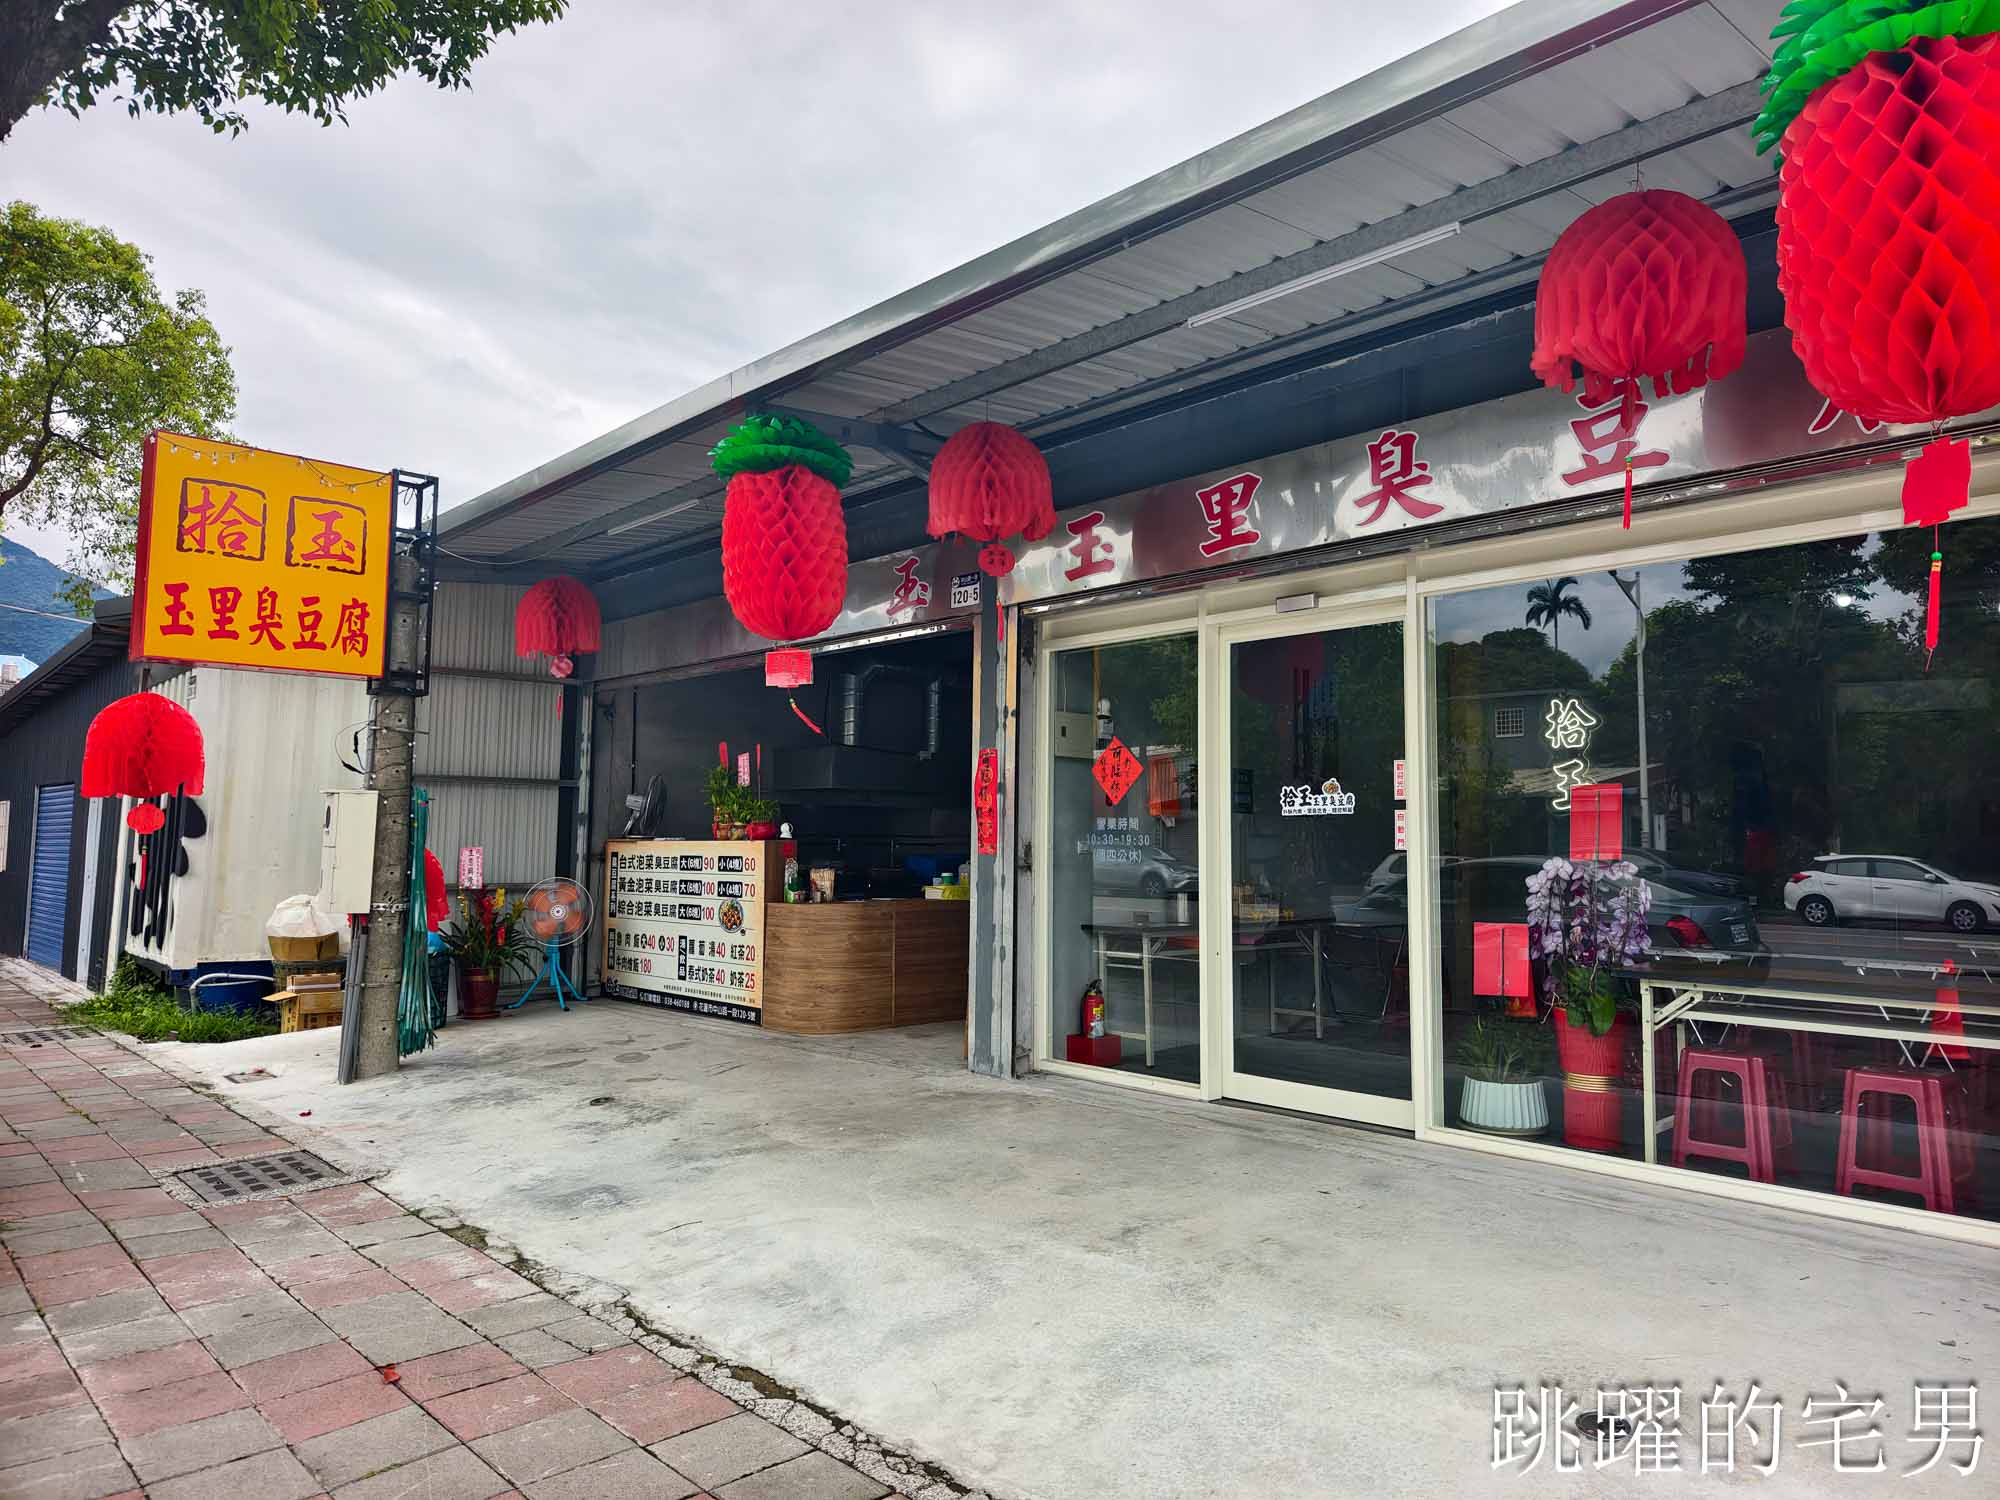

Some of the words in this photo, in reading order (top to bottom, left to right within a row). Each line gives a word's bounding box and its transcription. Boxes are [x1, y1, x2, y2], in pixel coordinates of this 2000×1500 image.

[159, 582, 370, 658] 玉里臭豆腐
[1282, 787, 1312, 807] 拾玉
[1096, 817, 1139, 831] 營業時間
[619, 854, 678, 870] 台式泡菜臭豆腐
[704, 857, 714, 870] 90
[745, 858, 755, 871] 60
[619, 877, 678, 894] 黃金泡菜臭豆腐
[703, 881, 715, 894] 100
[745, 883, 755, 897] 70
[618, 900, 677, 918] 綜合泡菜臭豆腐
[702, 907, 714, 920] 100
[648, 934, 655, 949] 40
[666, 936, 674, 952] 30
[716, 942, 725, 958] 40
[730, 944, 744, 960] 紅茶
[746, 945, 755, 961] 20
[640, 959, 651, 973] 180
[688, 965, 715, 983] 泰式奶茶
[716, 969, 725, 984] 40
[730, 970, 744, 988] 奶茶
[745, 972, 755, 989] 25
